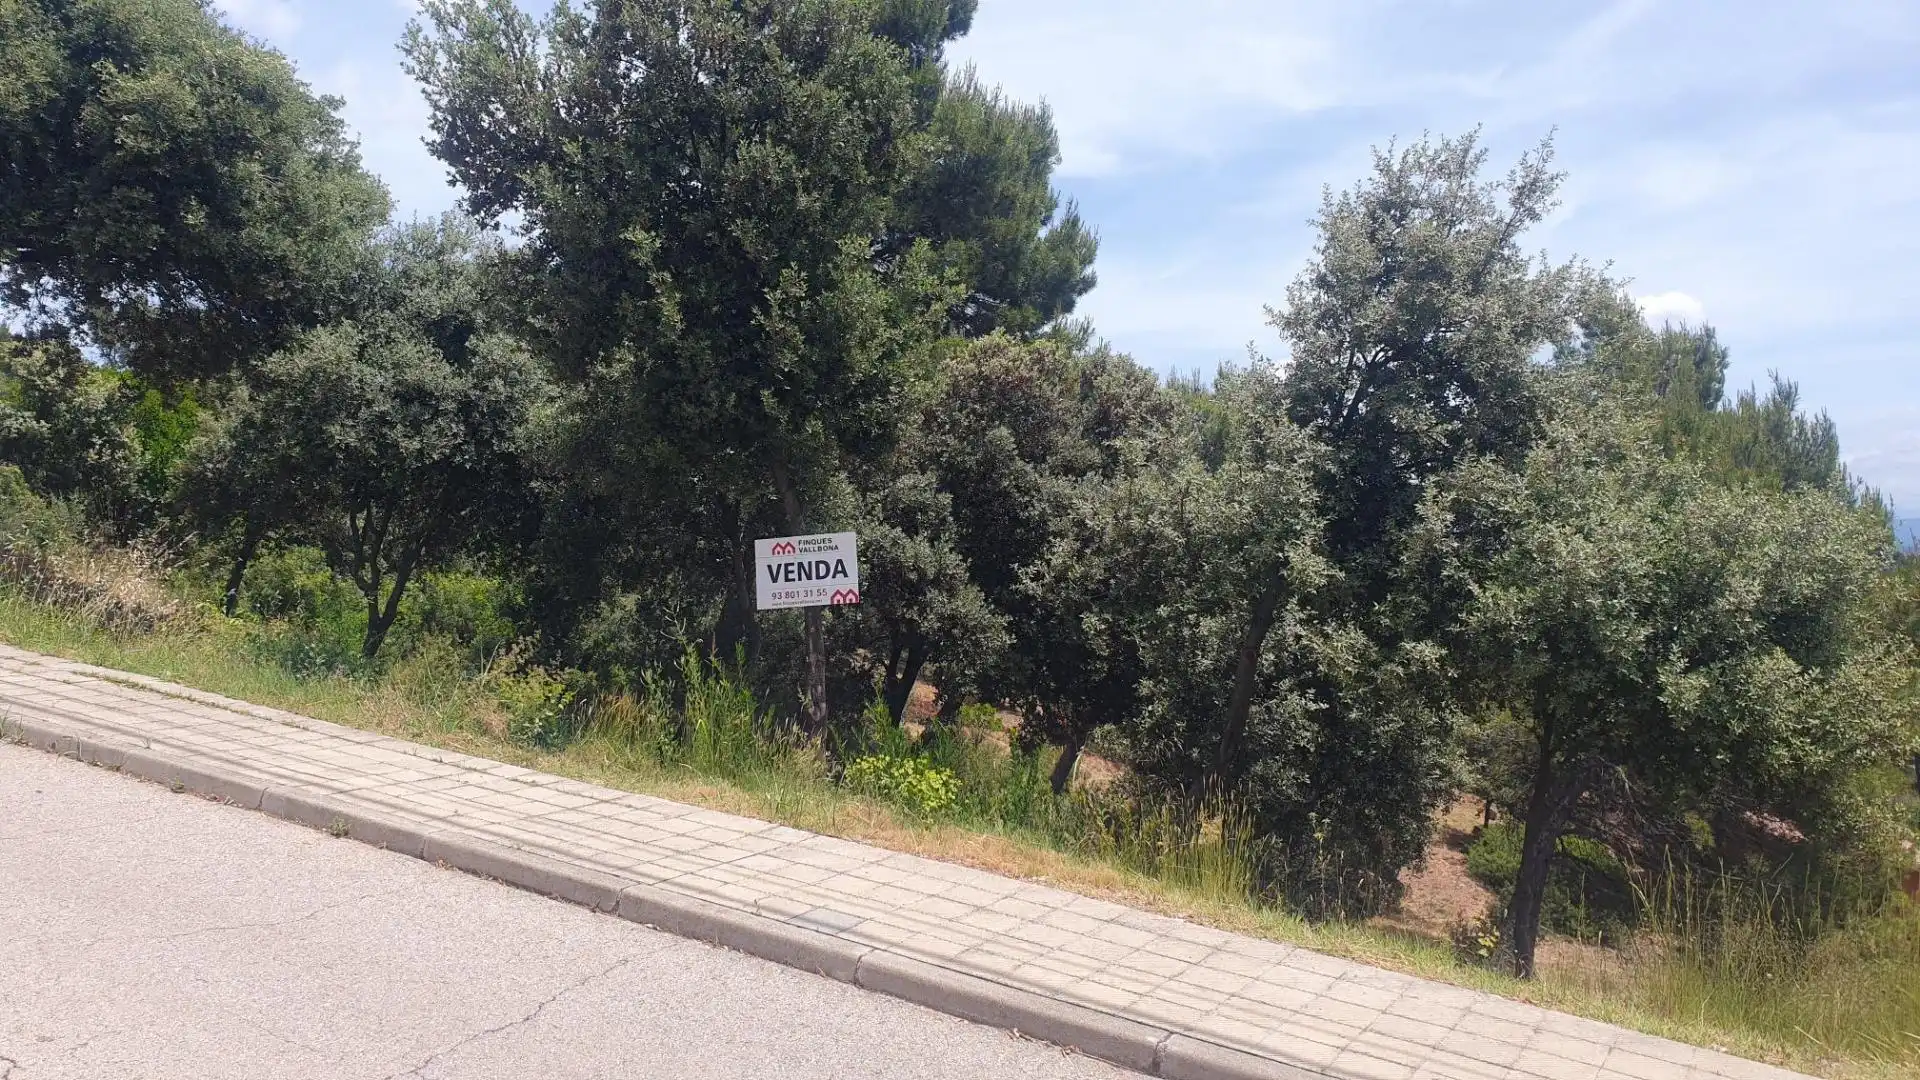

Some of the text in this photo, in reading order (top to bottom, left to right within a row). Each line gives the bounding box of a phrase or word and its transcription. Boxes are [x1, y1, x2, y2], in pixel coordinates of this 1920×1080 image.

[798, 538, 832, 546] FINQUES
[798, 545, 838, 553] VALLBONA
[767, 559, 848, 583] VENDA
[771, 589, 827, 600] 93 801 31 55
